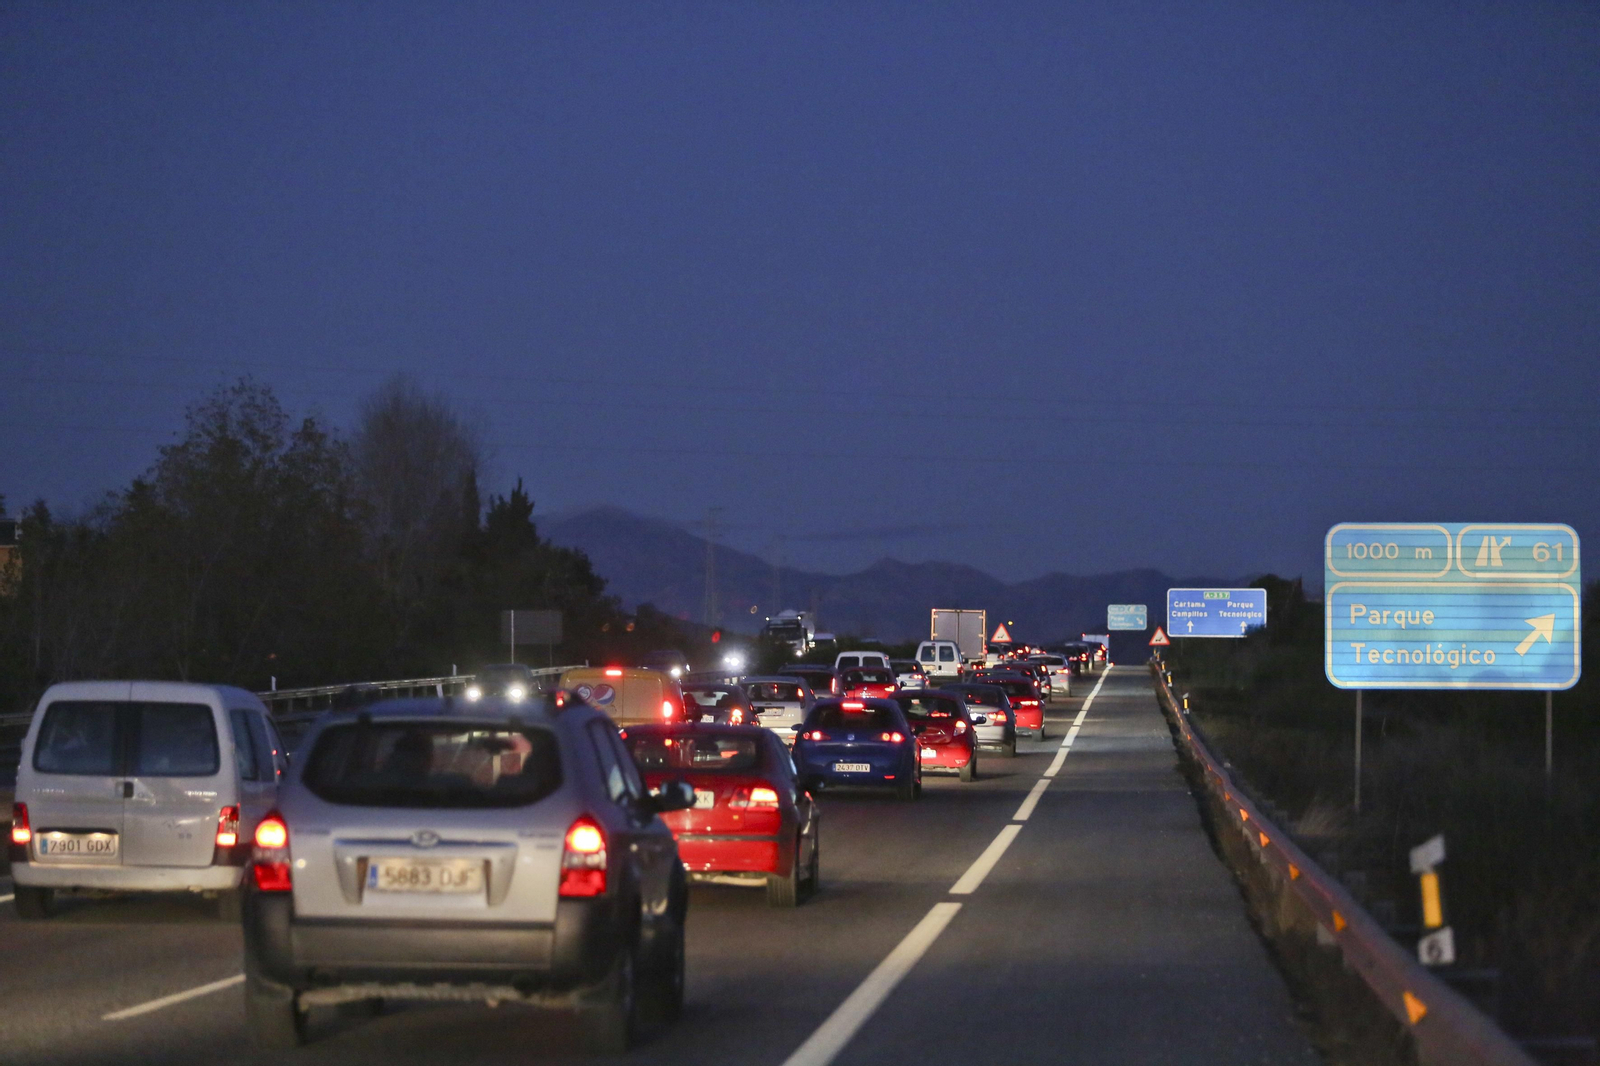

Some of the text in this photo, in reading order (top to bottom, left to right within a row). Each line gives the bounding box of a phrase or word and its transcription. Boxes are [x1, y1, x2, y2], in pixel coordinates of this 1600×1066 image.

[1346, 542, 1432, 560] 1000 m
[1532, 542, 1563, 562] 61
[1227, 601, 1254, 609] Parque
[1172, 610, 1208, 618] Campillos
[1219, 610, 1262, 619] Tecnológico
[1350, 603, 1435, 629] Parque
[1350, 643, 1496, 669] Tecnológico
[50, 839, 112, 852] 7901 GDX
